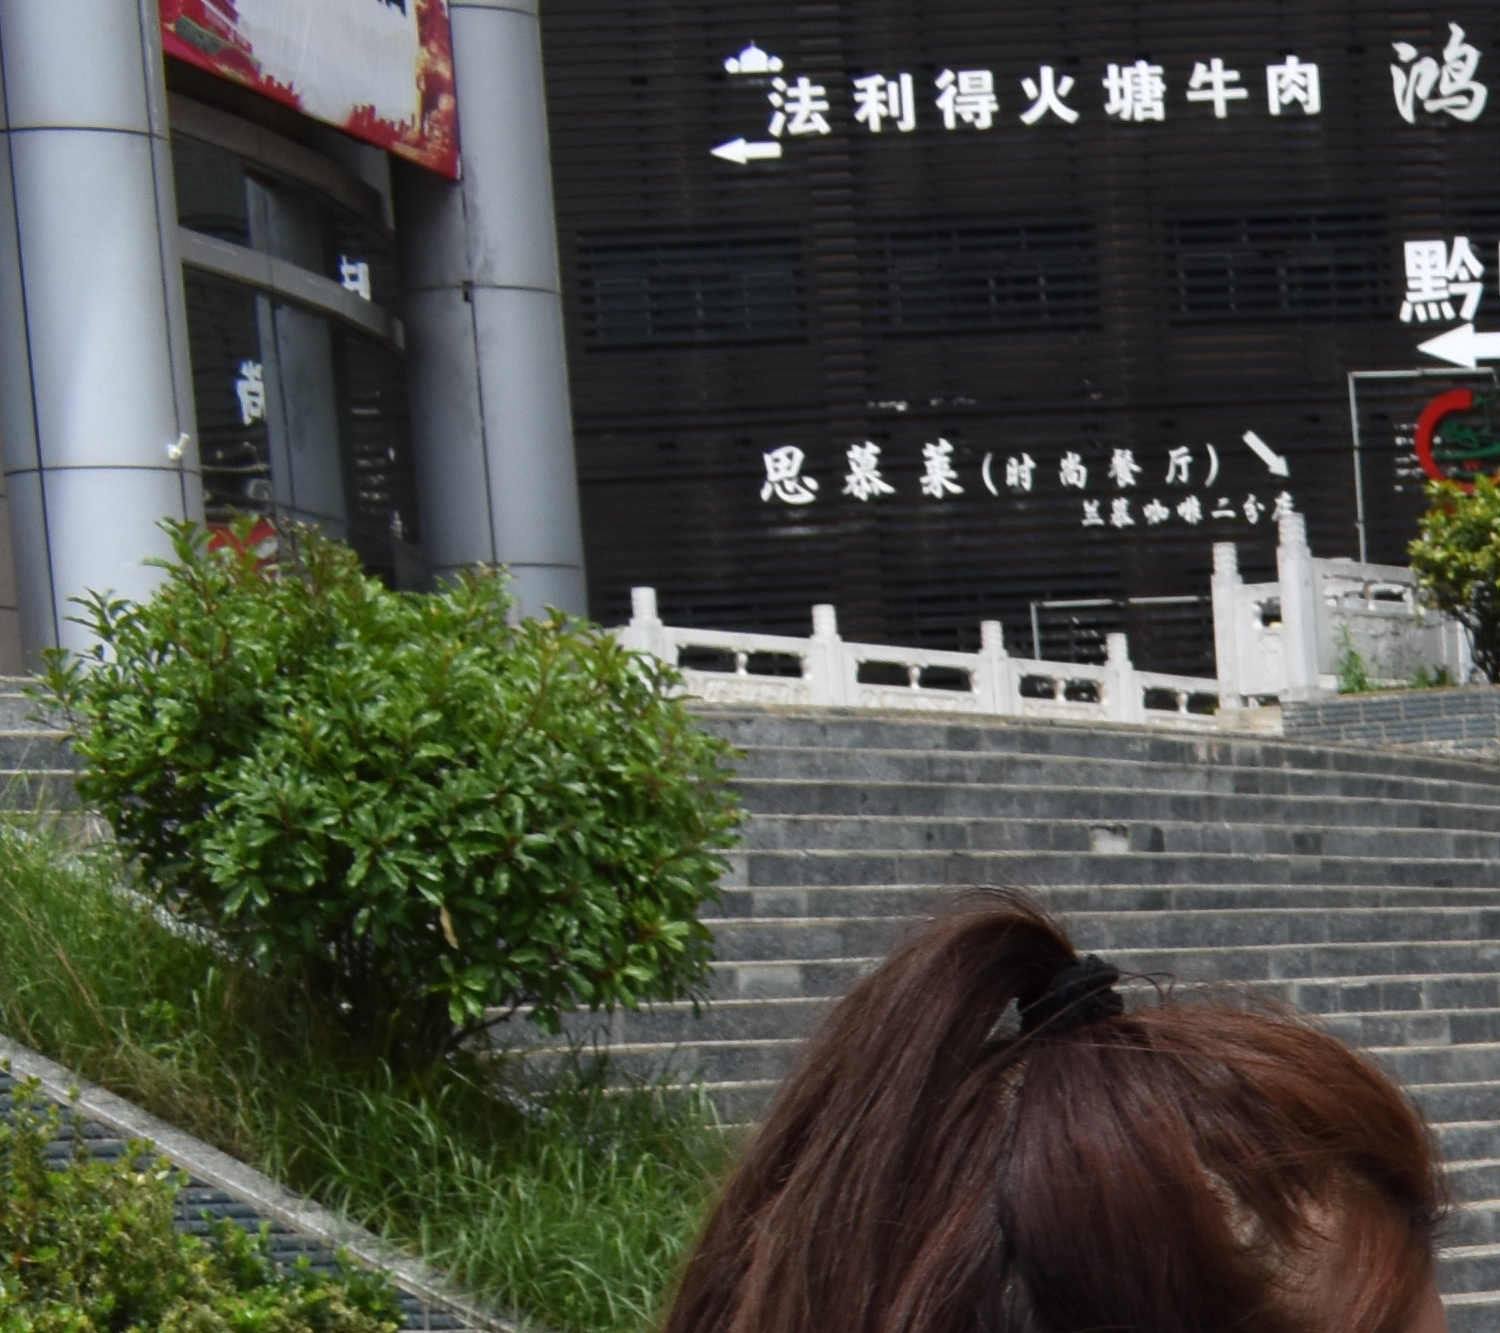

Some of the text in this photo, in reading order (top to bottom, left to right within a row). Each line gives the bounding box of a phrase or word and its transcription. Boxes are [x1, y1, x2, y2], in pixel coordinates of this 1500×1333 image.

[767, 55, 1322, 136] 法利得火塘牛肉
